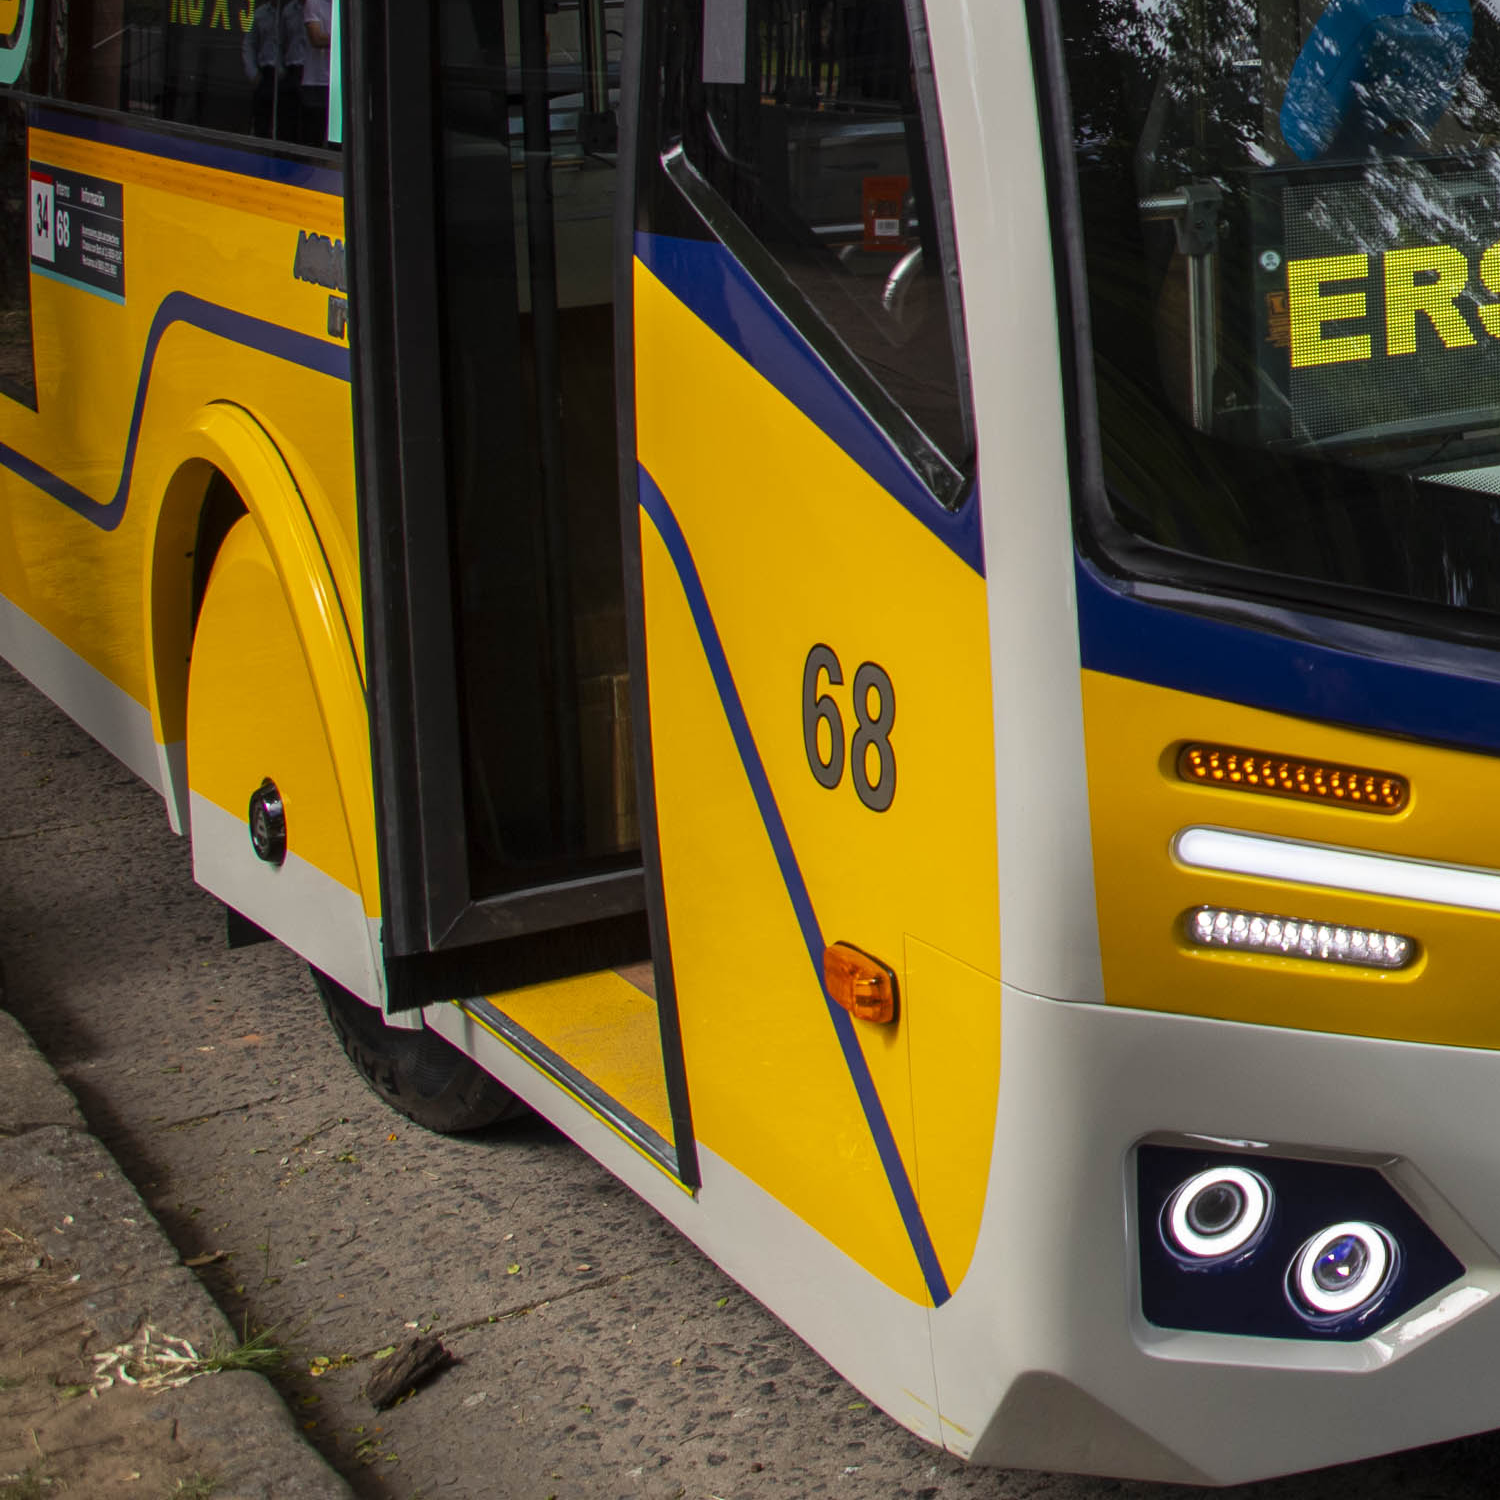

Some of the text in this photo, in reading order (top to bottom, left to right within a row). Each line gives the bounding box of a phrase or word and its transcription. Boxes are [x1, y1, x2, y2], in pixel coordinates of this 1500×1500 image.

[37, 193, 49, 238] 34
[56, 210, 71, 248] 68
[802, 643, 897, 813] 68
